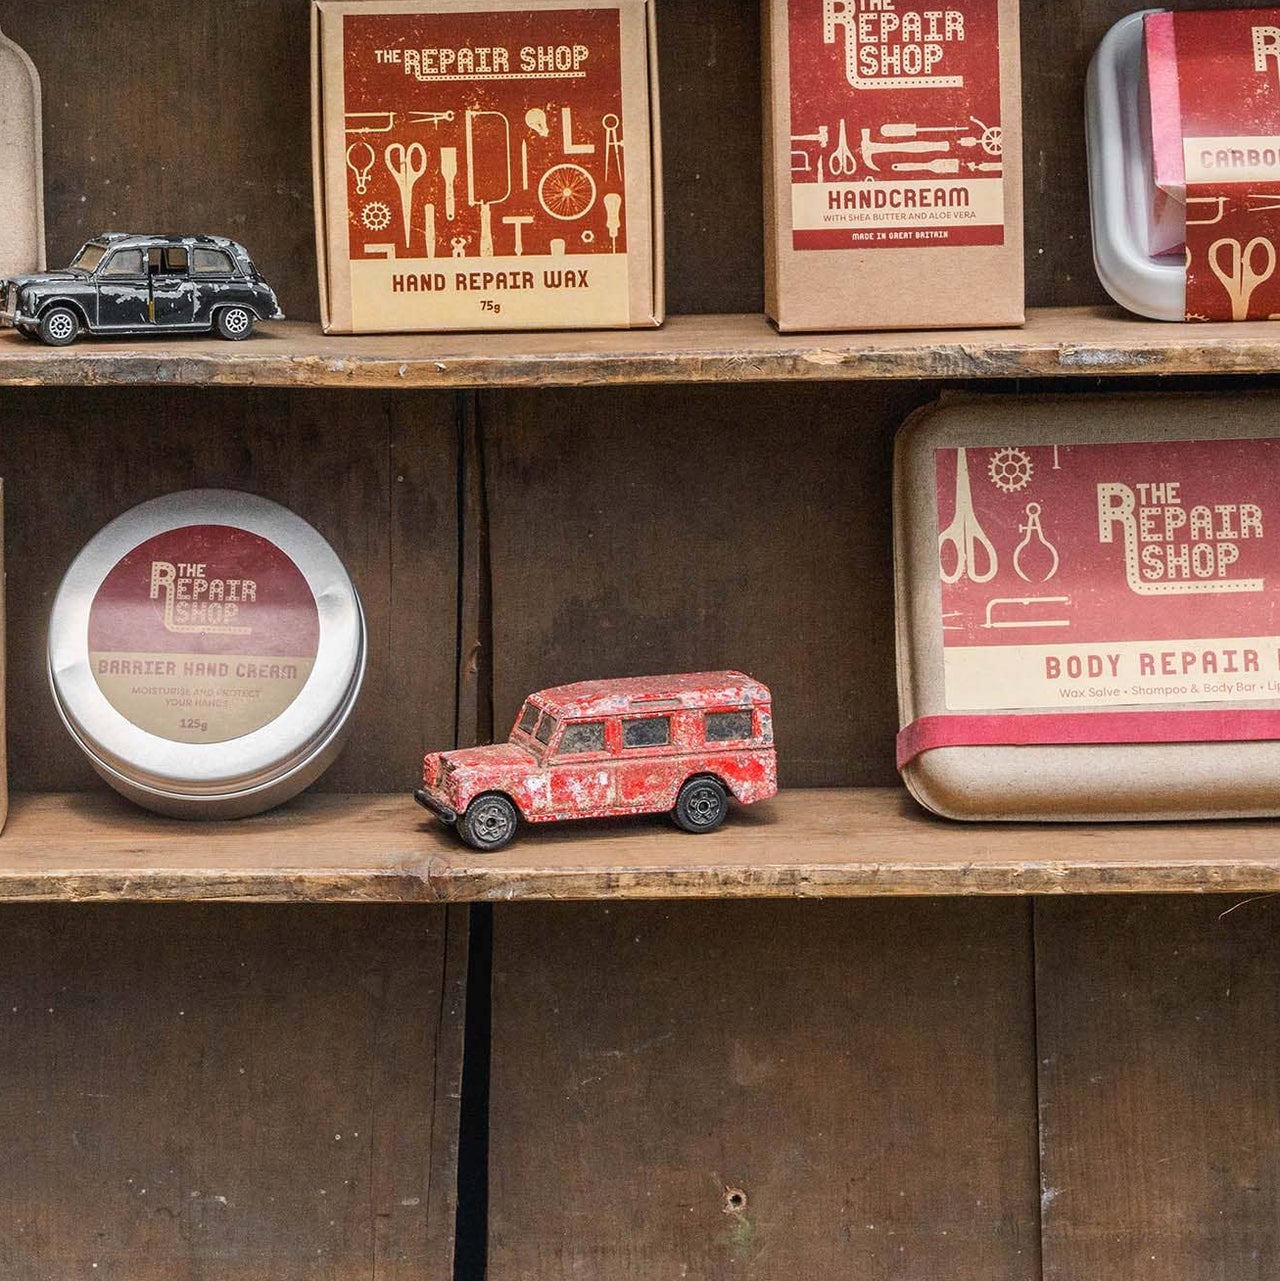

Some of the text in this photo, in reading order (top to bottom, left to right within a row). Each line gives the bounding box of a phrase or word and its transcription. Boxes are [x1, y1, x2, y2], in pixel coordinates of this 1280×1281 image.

[374, 45, 589, 74] THE REPAIR SHOP
[859, 44, 943, 75] SHOP
[828, 187, 969, 210] HANDCREAM
[823, 211, 976, 222] WITH SHEA BUTTER AND ALOE VERA
[852, 231, 948, 240] MADE IN GREAT BRITAIN
[392, 270, 589, 292] HAND REPAIR WAX
[480, 300, 501, 313] 75g
[1136, 482, 1180, 505] THE
[1097, 482, 1264, 543] REPAIR
[177, 563, 206, 577] THE
[1141, 543, 1239, 580] SHOP
[150, 561, 257, 602] REPAIR
[176, 601, 239, 624] SHOP
[98, 659, 298, 679] BARRIER HAND CREAM
[1045, 654, 1121, 679] BODY
[1139, 649, 1259, 676] REPAIR
[1059, 688, 1085, 698] Wax
[1089, 687, 1120, 697] Salve
[1131, 685, 1187, 696] Shampoo
[1191, 684, 1199, 693] &
[1204, 682, 1233, 693] Body
[1236, 682, 1256, 692] Bar
[180, 718, 208, 732] 125g
